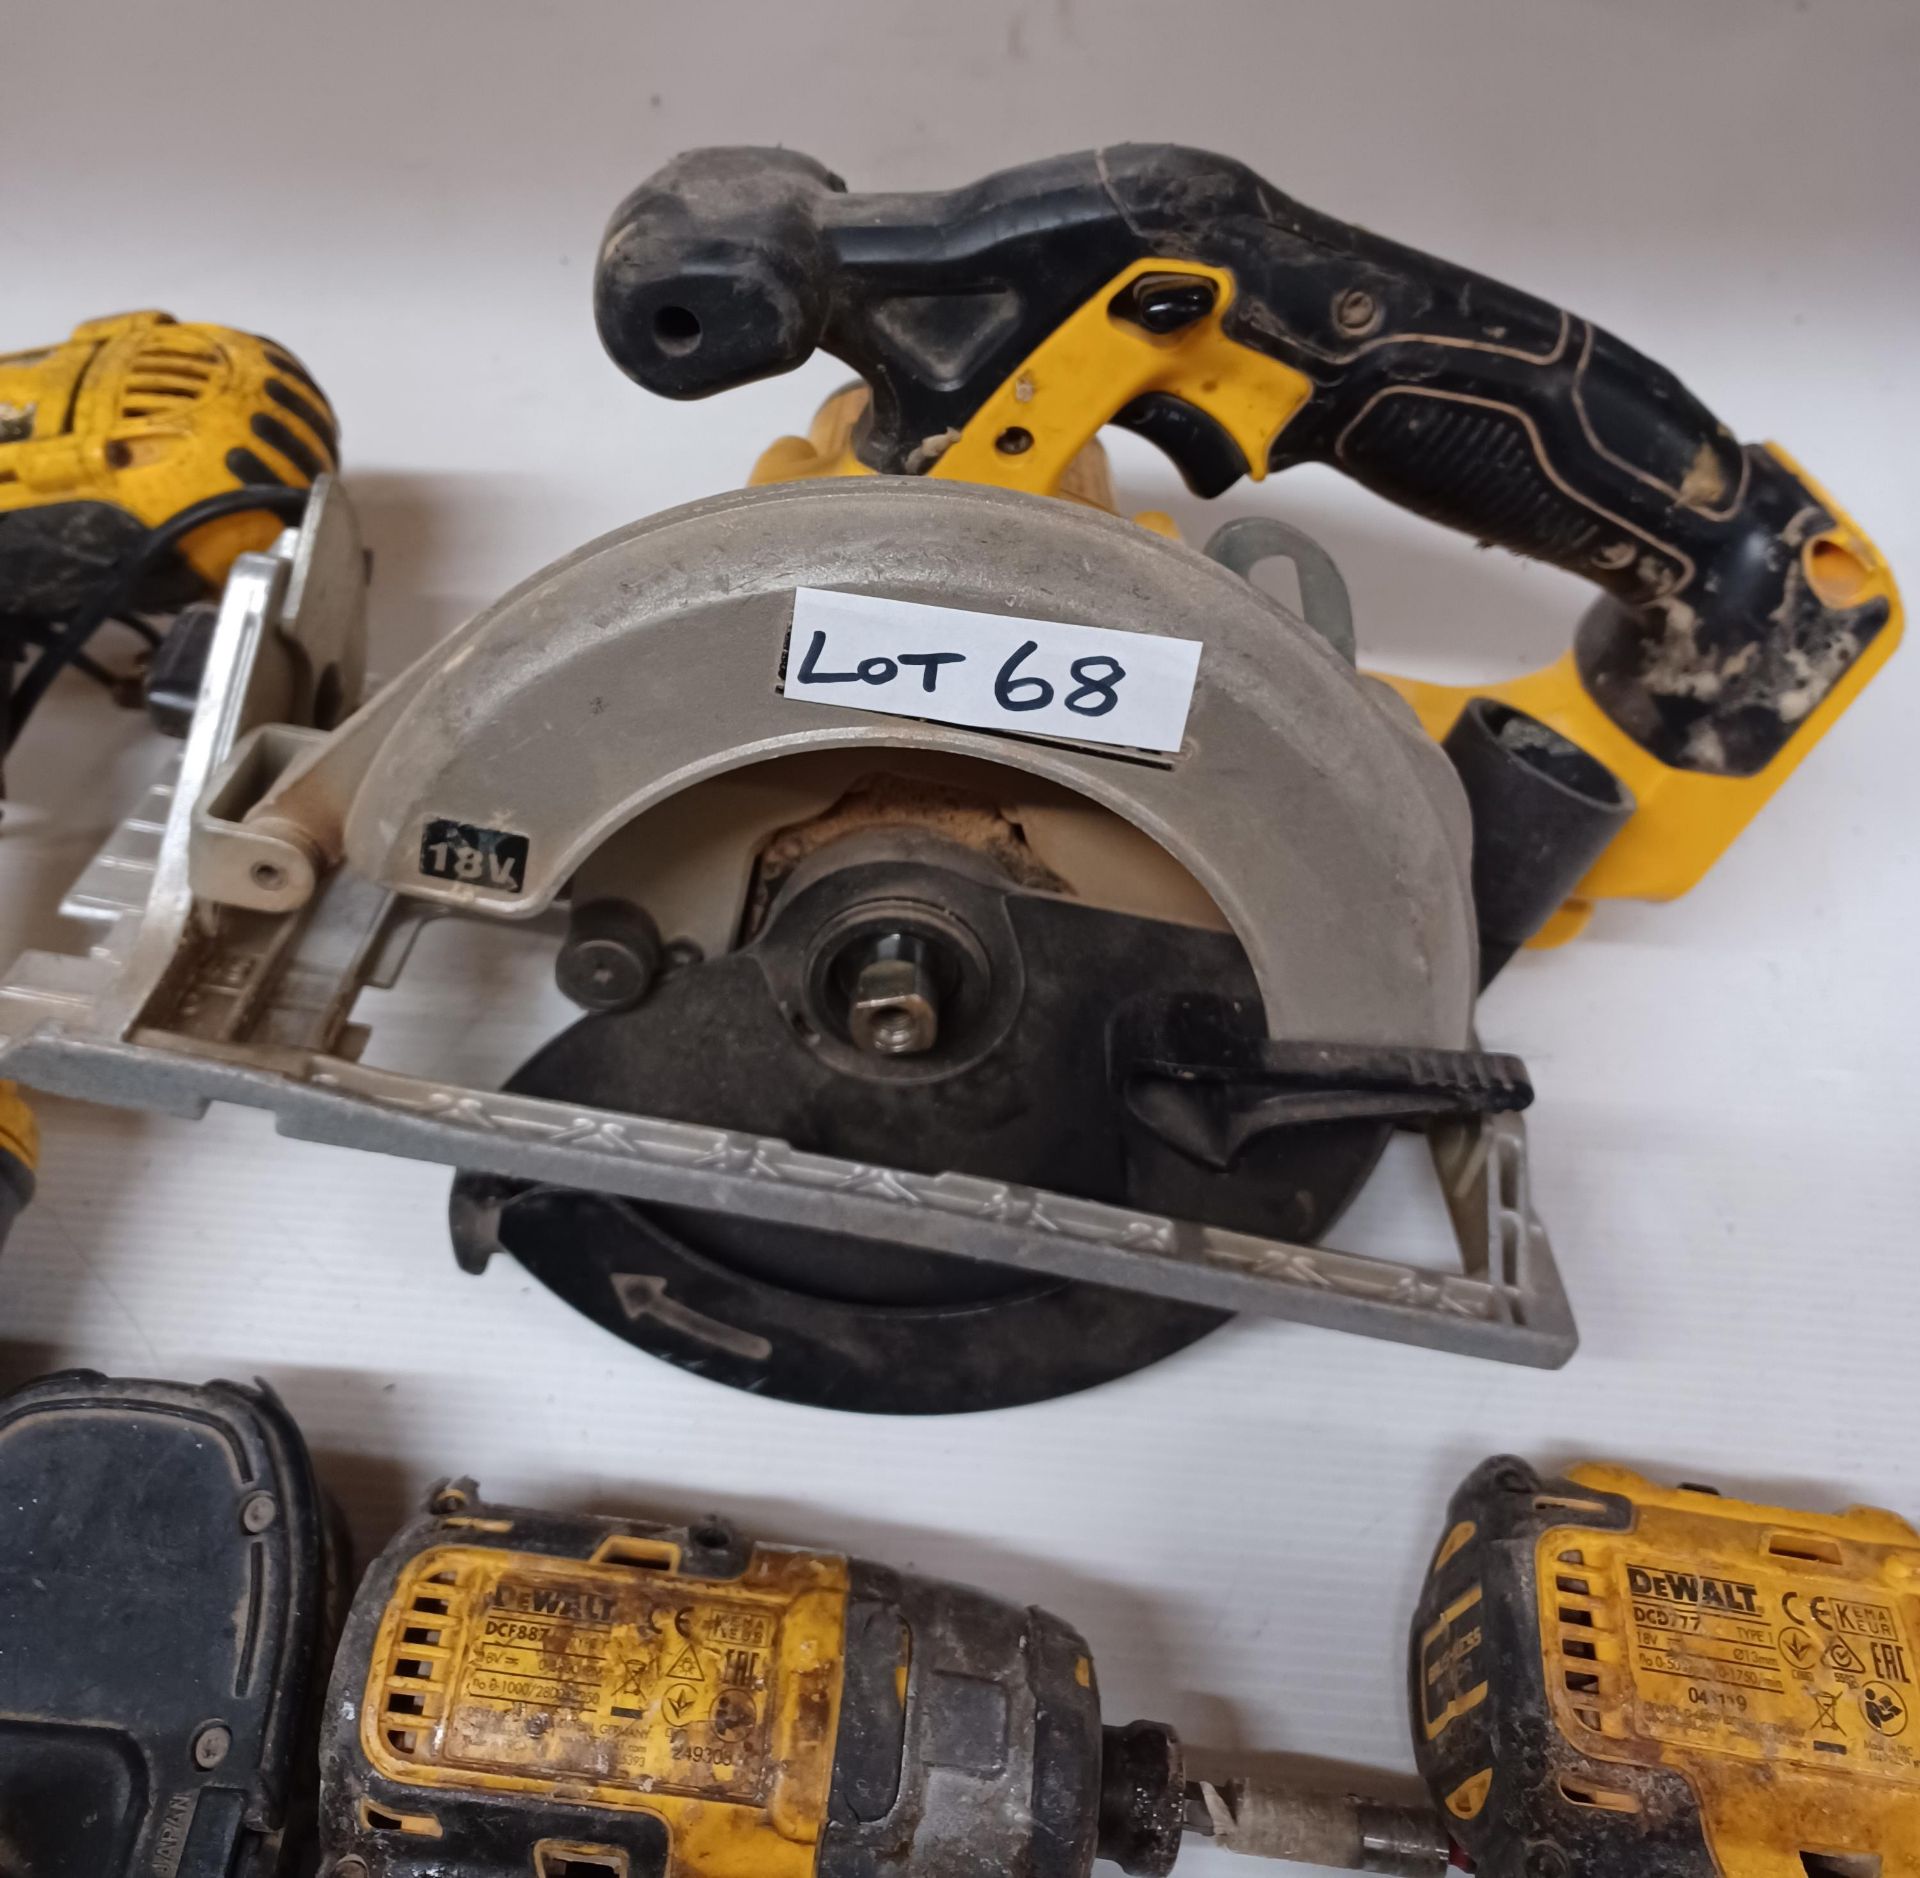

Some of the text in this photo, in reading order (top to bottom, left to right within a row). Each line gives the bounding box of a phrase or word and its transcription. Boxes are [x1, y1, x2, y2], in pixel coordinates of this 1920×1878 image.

[797, 630, 1126, 717] LOT 68
[428, 841, 518, 889] 18V
[485, 1620, 550, 1642] DCF887
[1637, 1631, 1658, 1646] 18V
[1738, 1626, 1765, 1643] TYPE
[152, 1792, 191, 1872] JAPAN
